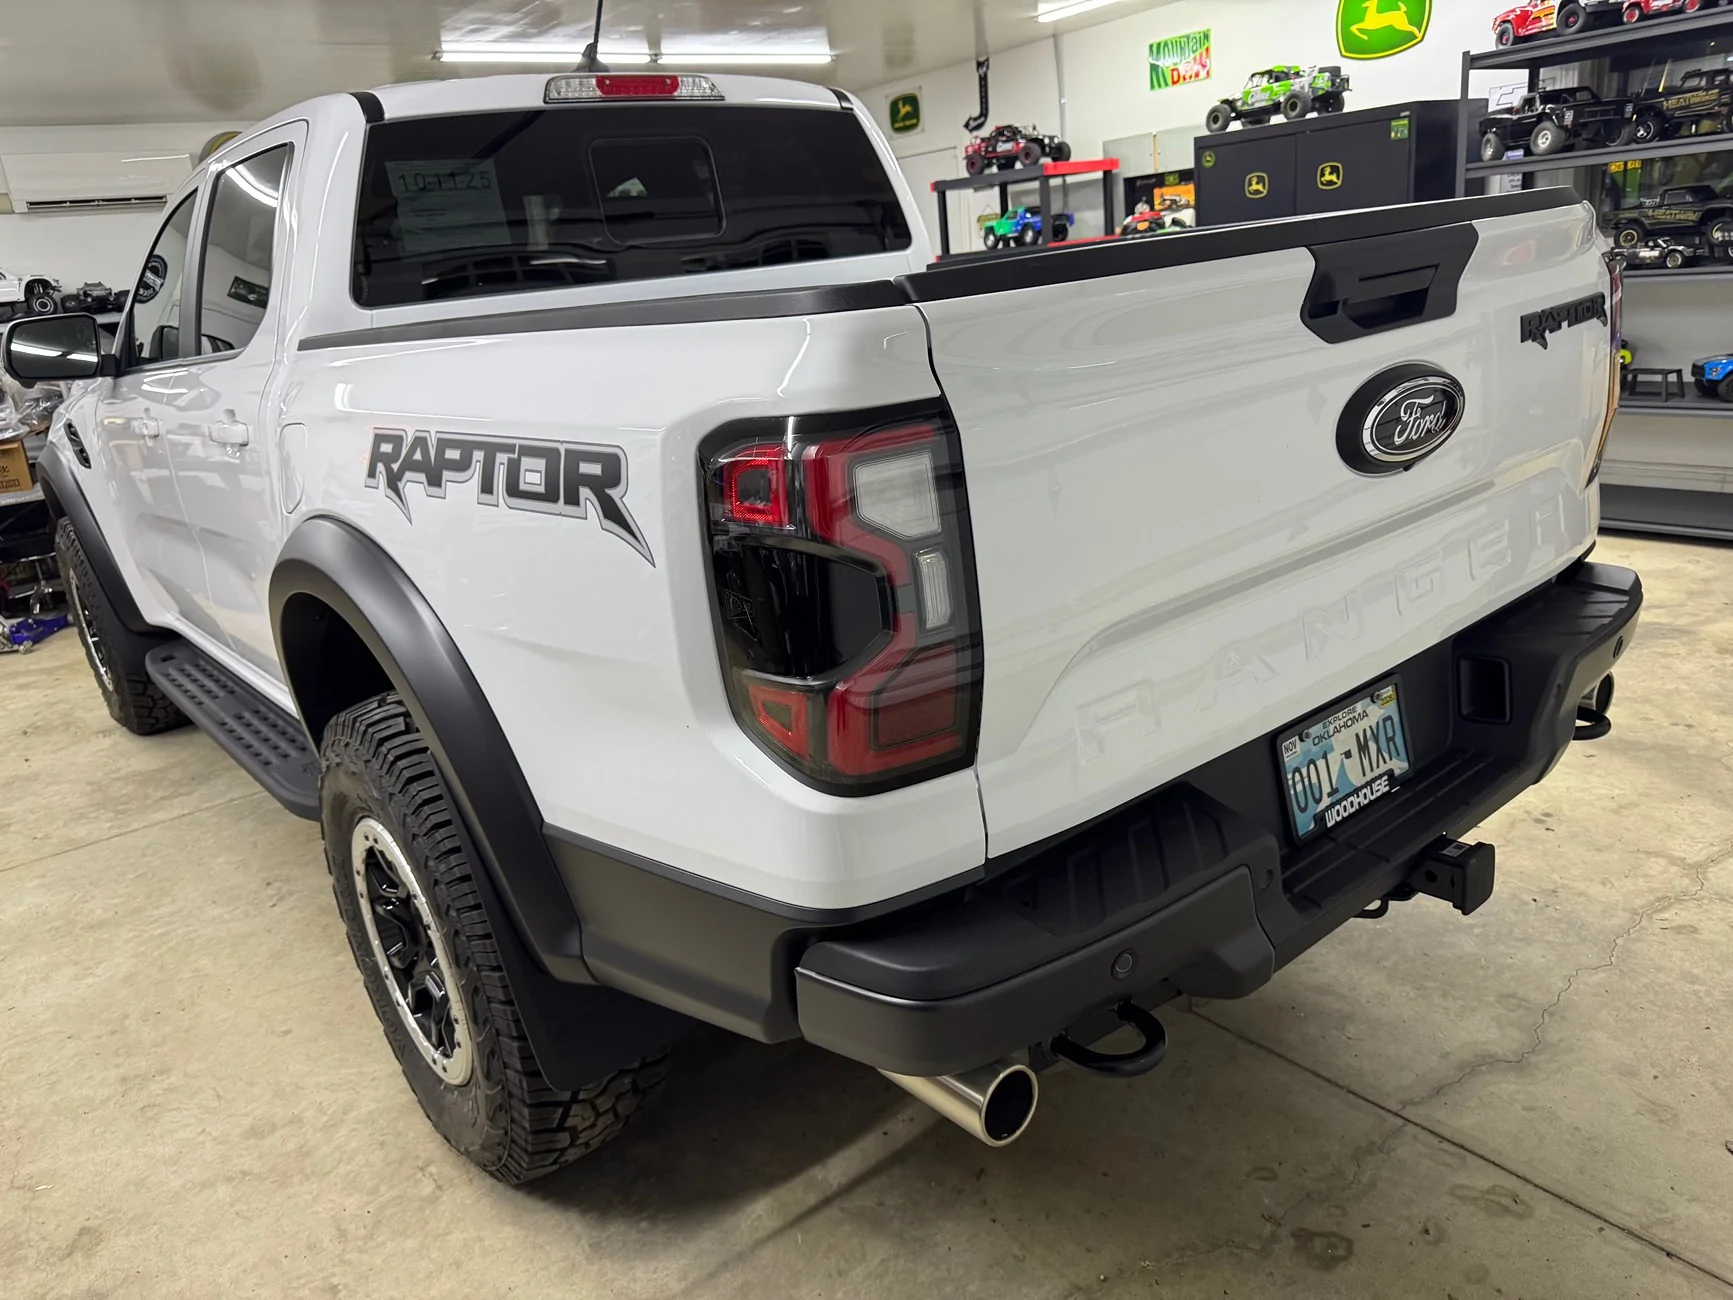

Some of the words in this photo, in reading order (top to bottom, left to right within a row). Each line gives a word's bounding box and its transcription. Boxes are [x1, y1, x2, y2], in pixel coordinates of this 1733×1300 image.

[1520, 291, 1608, 350] RAPTOR
[1394, 395, 1446, 446] Ford
[364, 427, 656, 568] RAPTOR
[1076, 493, 1567, 765] RANGER
[1312, 710, 1369, 746] OKLAHOMA
[1323, 706, 1357, 729] EXPLORE
[1284, 739, 1297, 755] NOV
[1292, 751, 1339, 814] 001
[1355, 715, 1400, 777] MXR
[1325, 775, 1390, 828] WOODHOUSE
